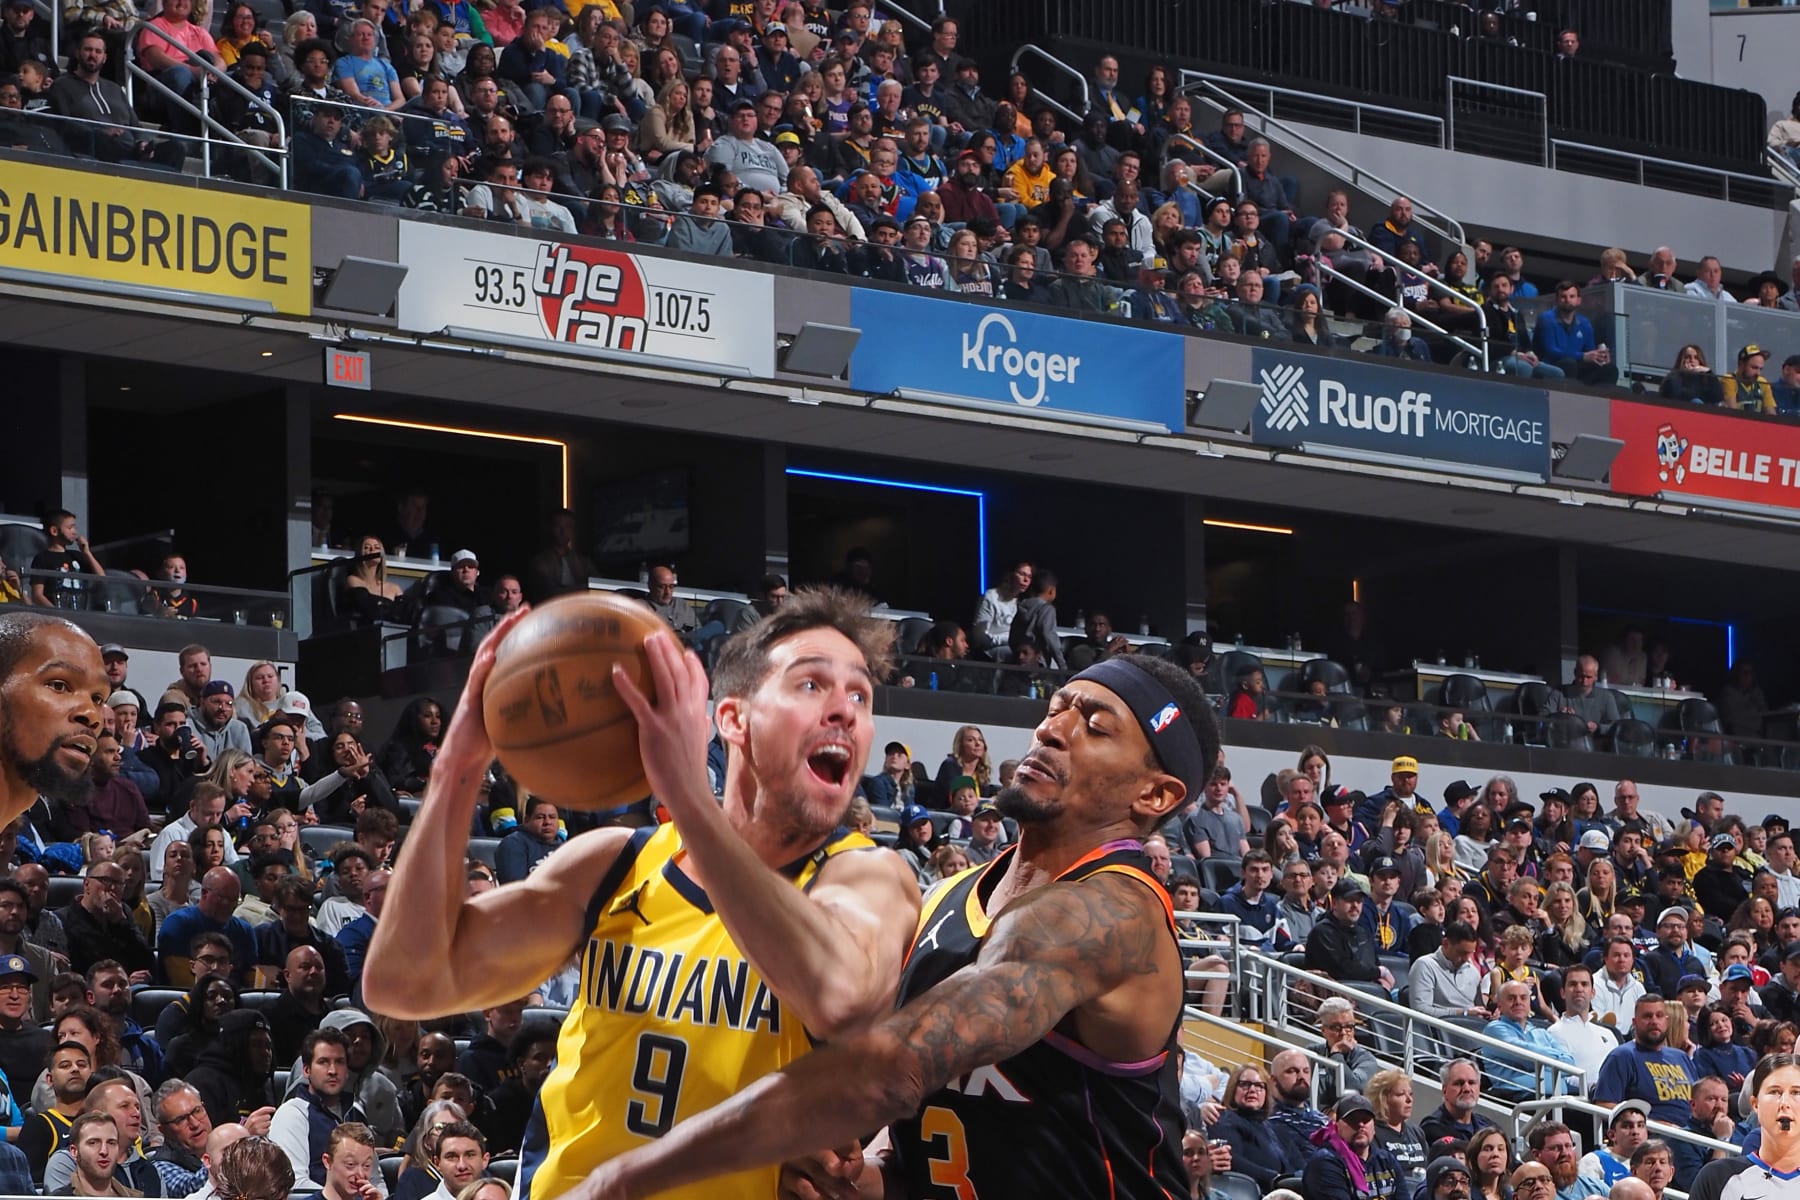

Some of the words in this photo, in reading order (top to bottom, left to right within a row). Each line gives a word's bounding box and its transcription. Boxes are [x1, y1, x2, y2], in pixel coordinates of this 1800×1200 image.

[1736, 34, 1746, 62] 7
[474, 265, 526, 307] 93.5
[532, 243, 622, 306] the
[553, 292, 649, 353] fan
[654, 291, 711, 333] 107.5
[334, 353, 364, 384] EXIT
[962, 312, 1080, 407] Kroger
[1319, 379, 1432, 437] Ruoff
[1435, 408, 1544, 445] MORTGAGE
[1689, 445, 1771, 484] BELLE
[585, 937, 782, 1035] INDIANA
[626, 1030, 689, 1140] 9
